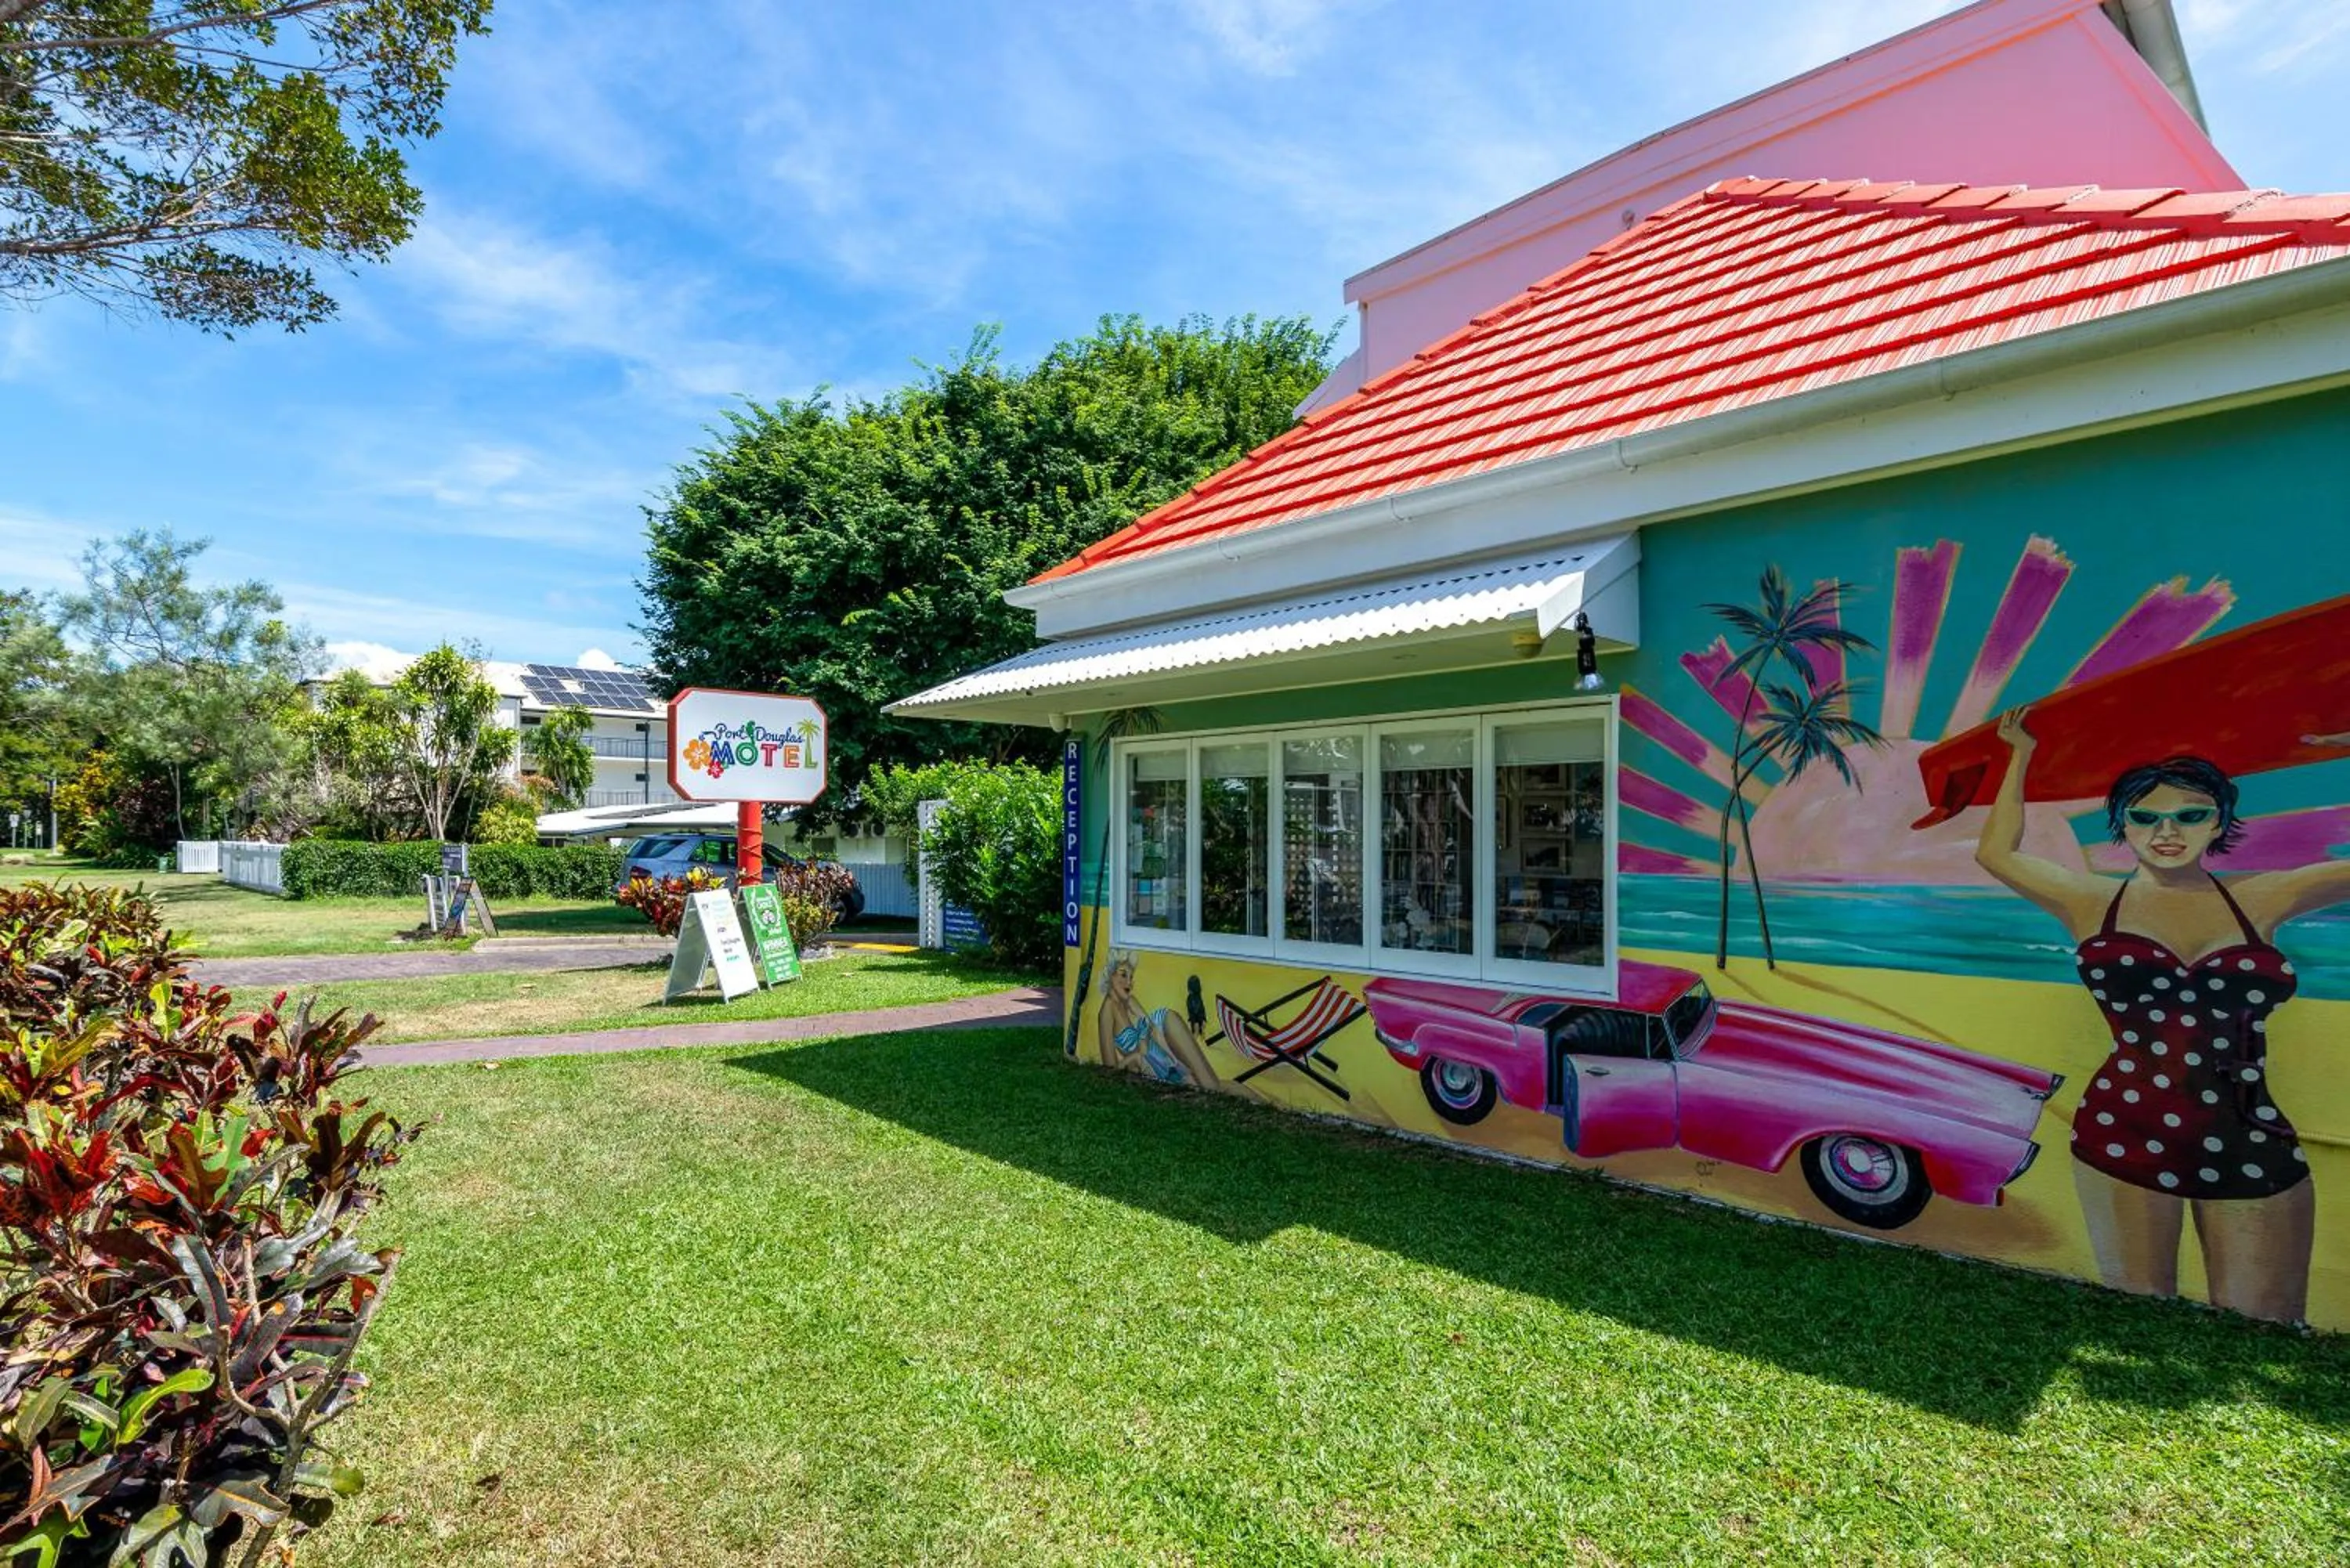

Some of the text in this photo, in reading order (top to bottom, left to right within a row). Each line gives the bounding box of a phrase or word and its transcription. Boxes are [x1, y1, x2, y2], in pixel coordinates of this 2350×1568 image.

[702, 723, 804, 750] Port Douglas
[710, 738, 817, 769] MOTEL
[1066, 742, 1079, 941] RECEPTION
